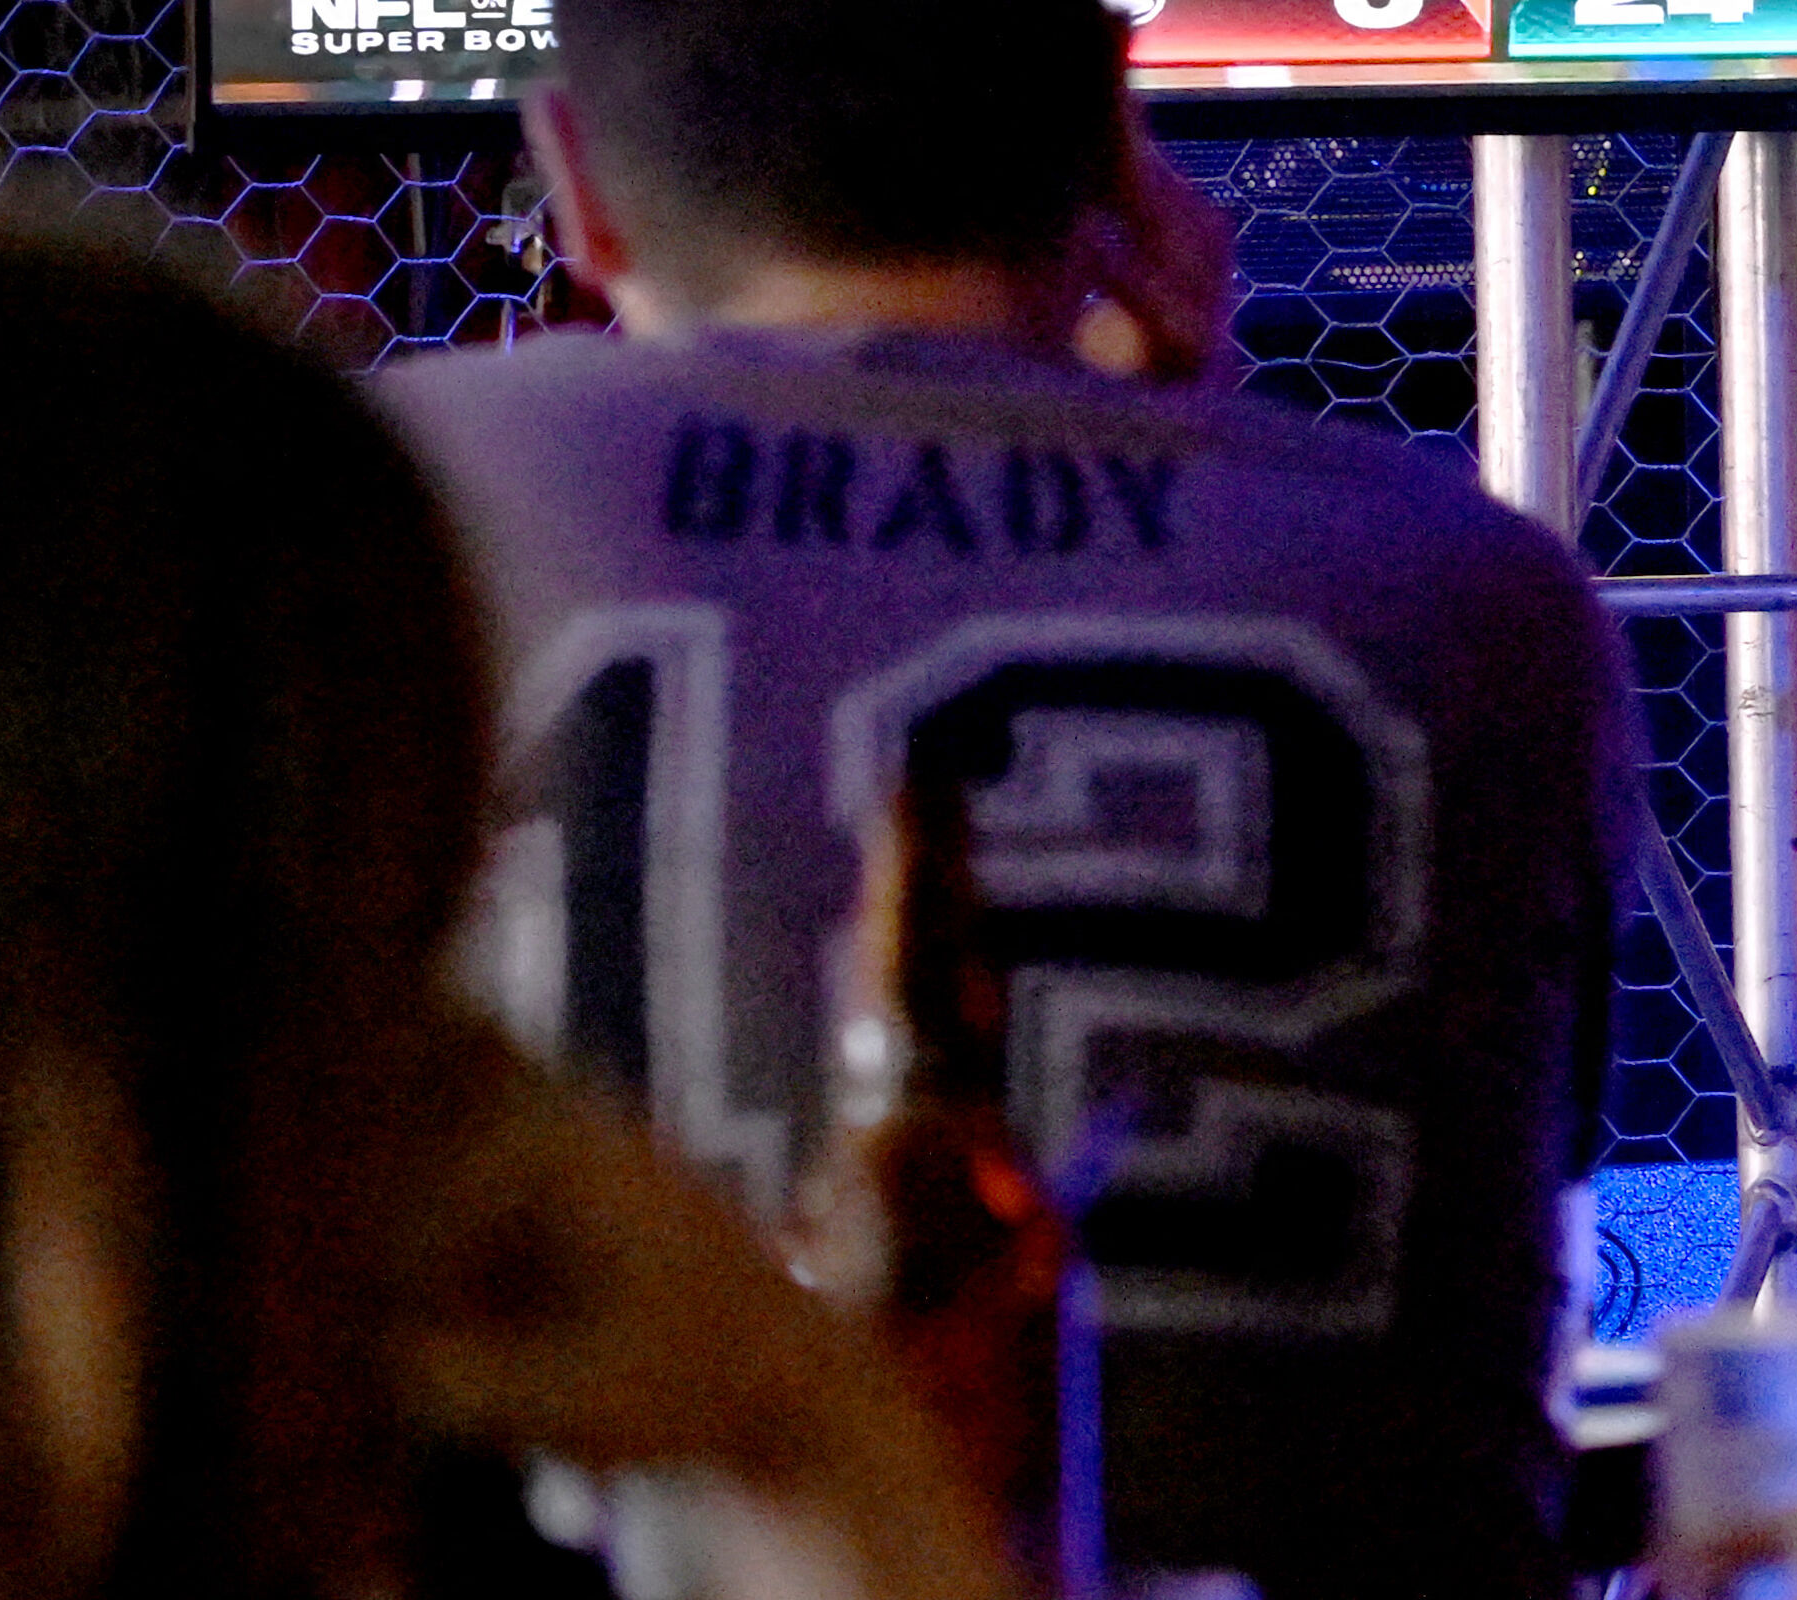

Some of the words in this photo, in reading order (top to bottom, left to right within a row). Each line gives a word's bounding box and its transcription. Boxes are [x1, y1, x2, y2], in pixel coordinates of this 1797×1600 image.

[291, 30, 446, 55] SUPER
[663, 410, 1177, 557] BRADY
[501, 605, 1431, 1334] 12
